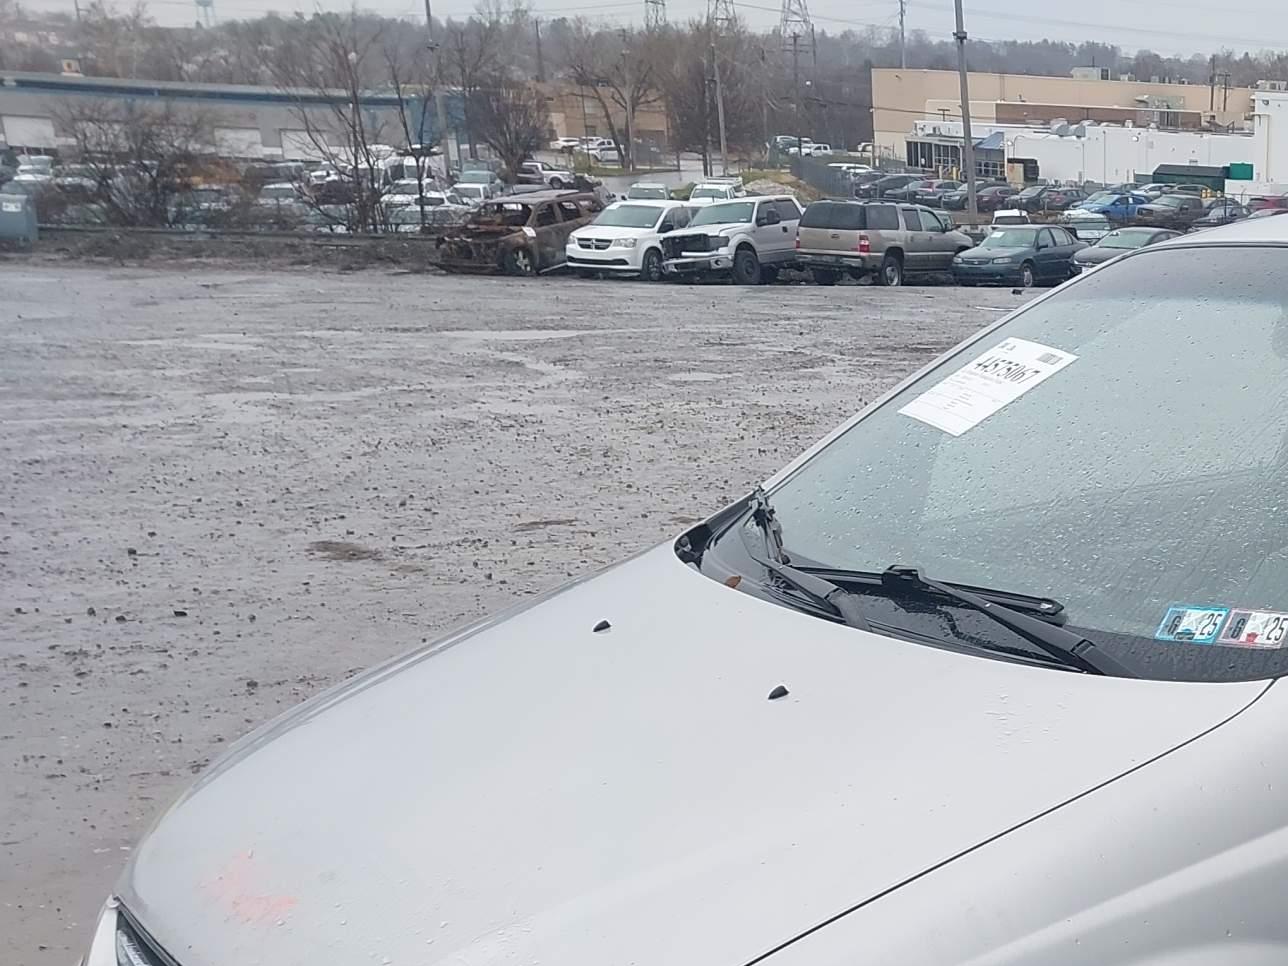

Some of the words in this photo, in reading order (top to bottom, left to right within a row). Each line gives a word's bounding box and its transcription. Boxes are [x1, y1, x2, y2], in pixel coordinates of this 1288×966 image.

[974, 355, 1041, 384] 44575067
[1199, 613, 1223, 636] 25
[1230, 618, 1246, 639] 6
